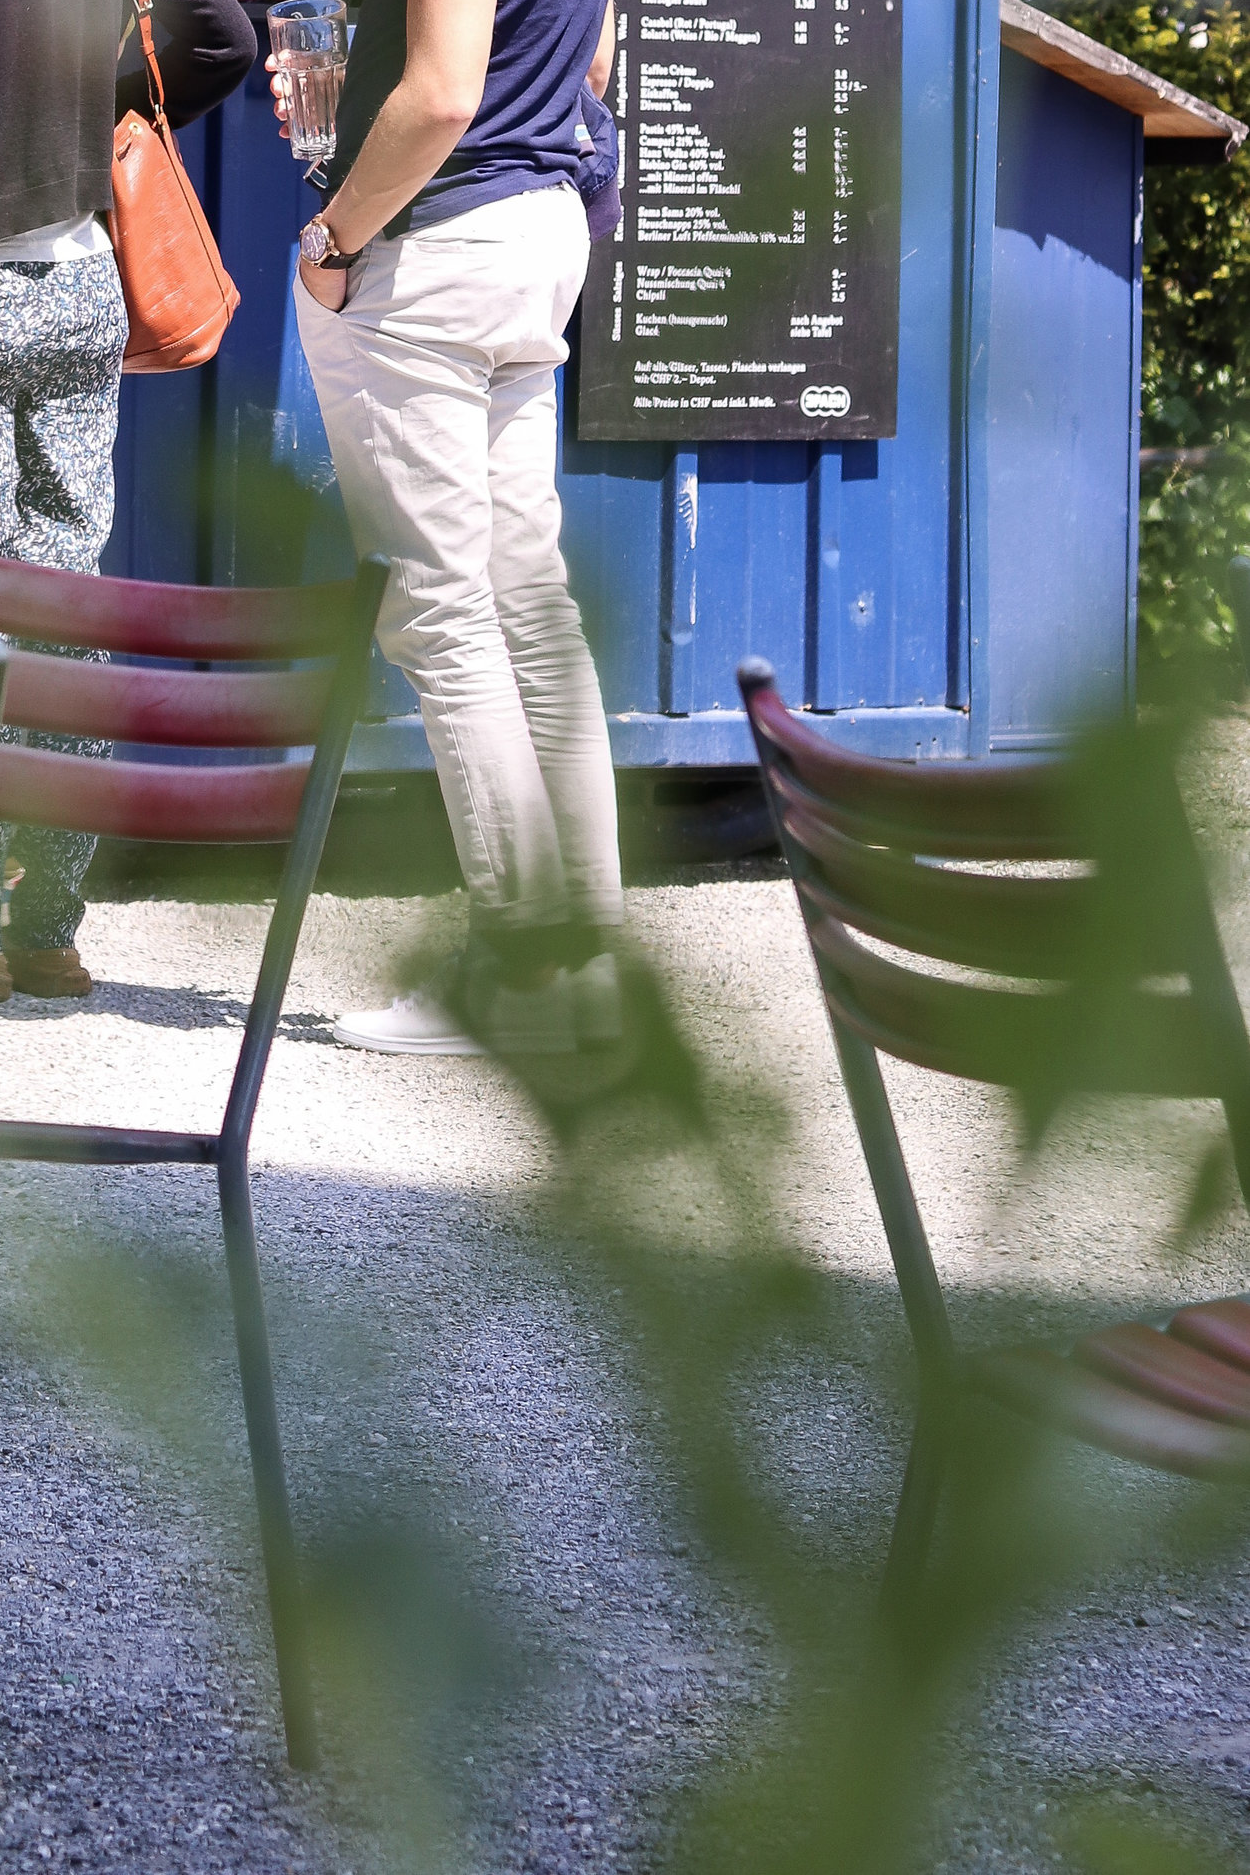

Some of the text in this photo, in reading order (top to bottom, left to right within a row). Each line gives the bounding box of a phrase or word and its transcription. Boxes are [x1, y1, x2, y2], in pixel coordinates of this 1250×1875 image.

[617, 13, 628, 41] Wein
[641, 64, 668, 75] Kaffee
[641, 76, 714, 90] Espresso Doppio
[641, 88, 679, 99] Eiskaffee
[640, 100, 691, 111] Diverse Tees
[640, 123, 701, 135] Pastis 45% vol.
[639, 136, 674, 148] Campari
[695, 137, 710, 147] vol.
[663, 148, 725, 159] Vodka 40% vol.
[672, 160, 687, 170] Gin
[689, 160, 707, 170] 40%
[709, 161, 724, 170] vol.
[664, 172, 695, 182] Mineral
[697, 172, 718, 182] offen
[663, 184, 695, 194] Mineral
[697, 184, 707, 194] im
[685, 207, 703, 218] 20%
[705, 208, 720, 218] vol.
[794, 211, 805, 220] 2cl
[693, 219, 711, 230] 25%
[712, 220, 728, 230] vol.
[793, 223, 805, 232] 2cl
[638, 230, 671, 242] Berliner
[673, 231, 691, 242] Luft
[760, 232, 776, 243] 18%
[778, 234, 792, 243] vol.
[793, 234, 805, 243] 2cl
[637, 266, 660, 279] Wrap
[637, 278, 696, 291] Nussmischung
[636, 290, 666, 302] Chipsli
[636, 313, 667, 325] Kuchen
[790, 315, 843, 327] nach Angebot
[812, 327, 832, 338] Tafel
[700, 362, 730, 374] Tassen,
[732, 363, 766, 373] Flaschen
[768, 363, 806, 374] verlangen
[650, 374, 672, 384] CHF
[690, 374, 716, 387] Depot.
[652, 397, 679, 408] Preise
[680, 398, 689, 408] in
[690, 398, 711, 408] CHF
[713, 398, 727, 408] und
